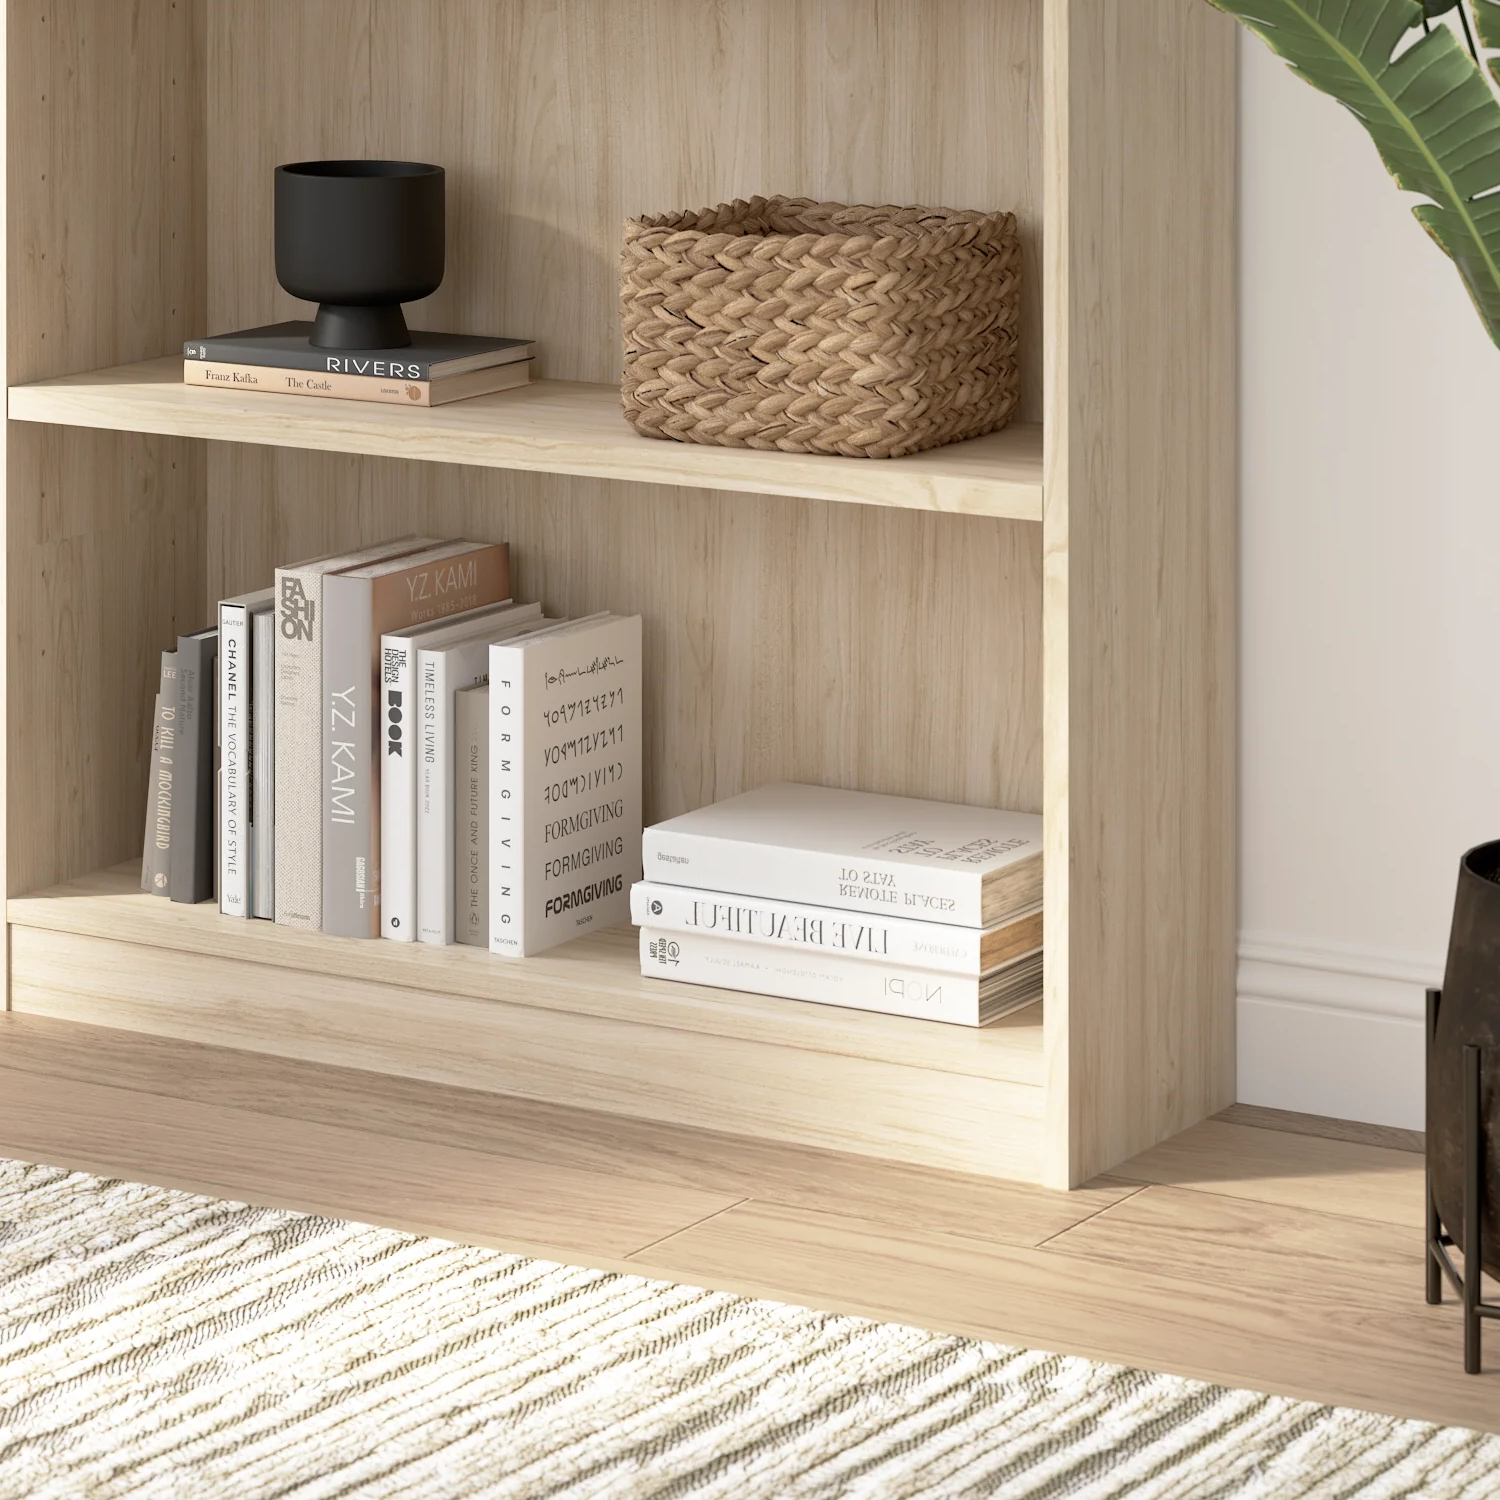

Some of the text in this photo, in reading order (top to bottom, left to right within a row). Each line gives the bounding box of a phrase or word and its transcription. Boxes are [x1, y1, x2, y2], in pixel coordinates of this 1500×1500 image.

[205, 370, 332, 390] Franz Kafka The Castle
[326, 356, 420, 379] RIVERS
[282, 576, 306, 601] FA
[405, 559, 478, 602] Y.Z. KAMI
[281, 598, 315, 622] SHI
[281, 616, 313, 642] ON
[410, 608, 436, 622] Works
[164, 670, 176, 679] LEE
[384, 648, 392, 684] HOTELS
[392, 648, 400, 683] DESIGN
[398, 650, 406, 668] THE
[388, 690, 402, 758] BOOK
[424, 662, 435, 763] TIMELESS LIVING
[228, 638, 236, 876] CHANEL THE VOCABULARY OF STYLE
[331, 686, 356, 824] Y.Z. KAMI
[155, 706, 175, 849] TO KILL MOCKINGBIRD
[470, 744, 478, 884] ONCE AND FUTURE KING
[501, 680, 511, 925] FORMGIVING
[544, 799, 624, 843] FORMGIVING
[544, 836, 623, 881] FORMGIVING
[544, 874, 623, 918] FORMGIVING
[494, 938, 518, 946] TASCHEN
